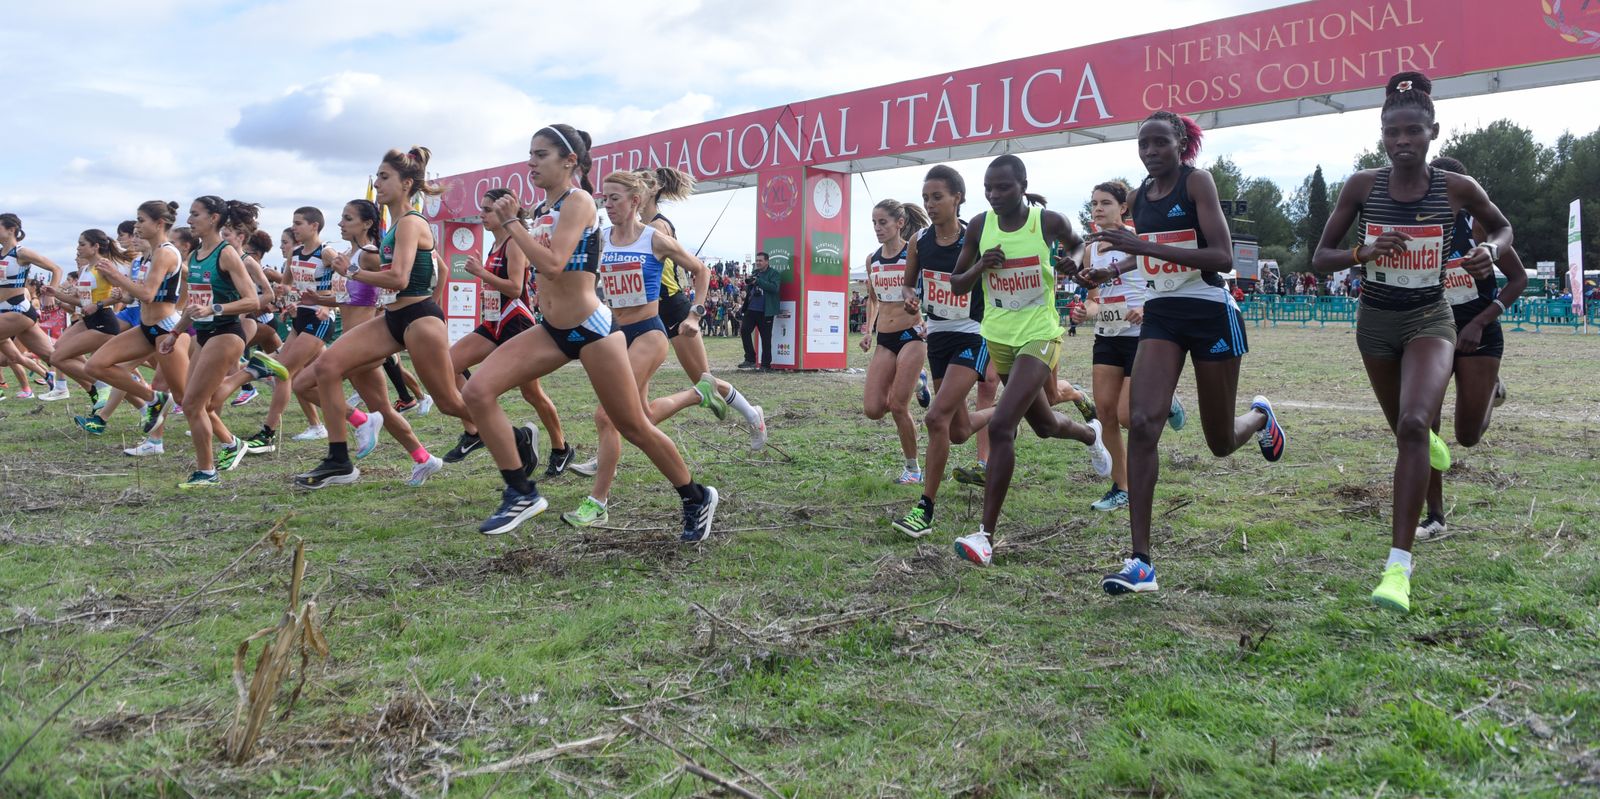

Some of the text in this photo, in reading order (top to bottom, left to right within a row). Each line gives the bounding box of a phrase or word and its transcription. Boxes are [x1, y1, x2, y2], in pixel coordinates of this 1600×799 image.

[1144, 0, 1424, 72] INTERNATIONAL
[1142, 39, 1445, 111] CROSS COUNTRY
[573, 107, 859, 195] TERNACIONAL
[878, 62, 1114, 151] ITÁLICA
[815, 256, 840, 265] SEVILLA
[603, 272, 643, 295] PELAYO
[989, 269, 1041, 295] Chepkirui
[1444, 271, 1474, 289] eting
[1100, 309, 1122, 322] 1601
